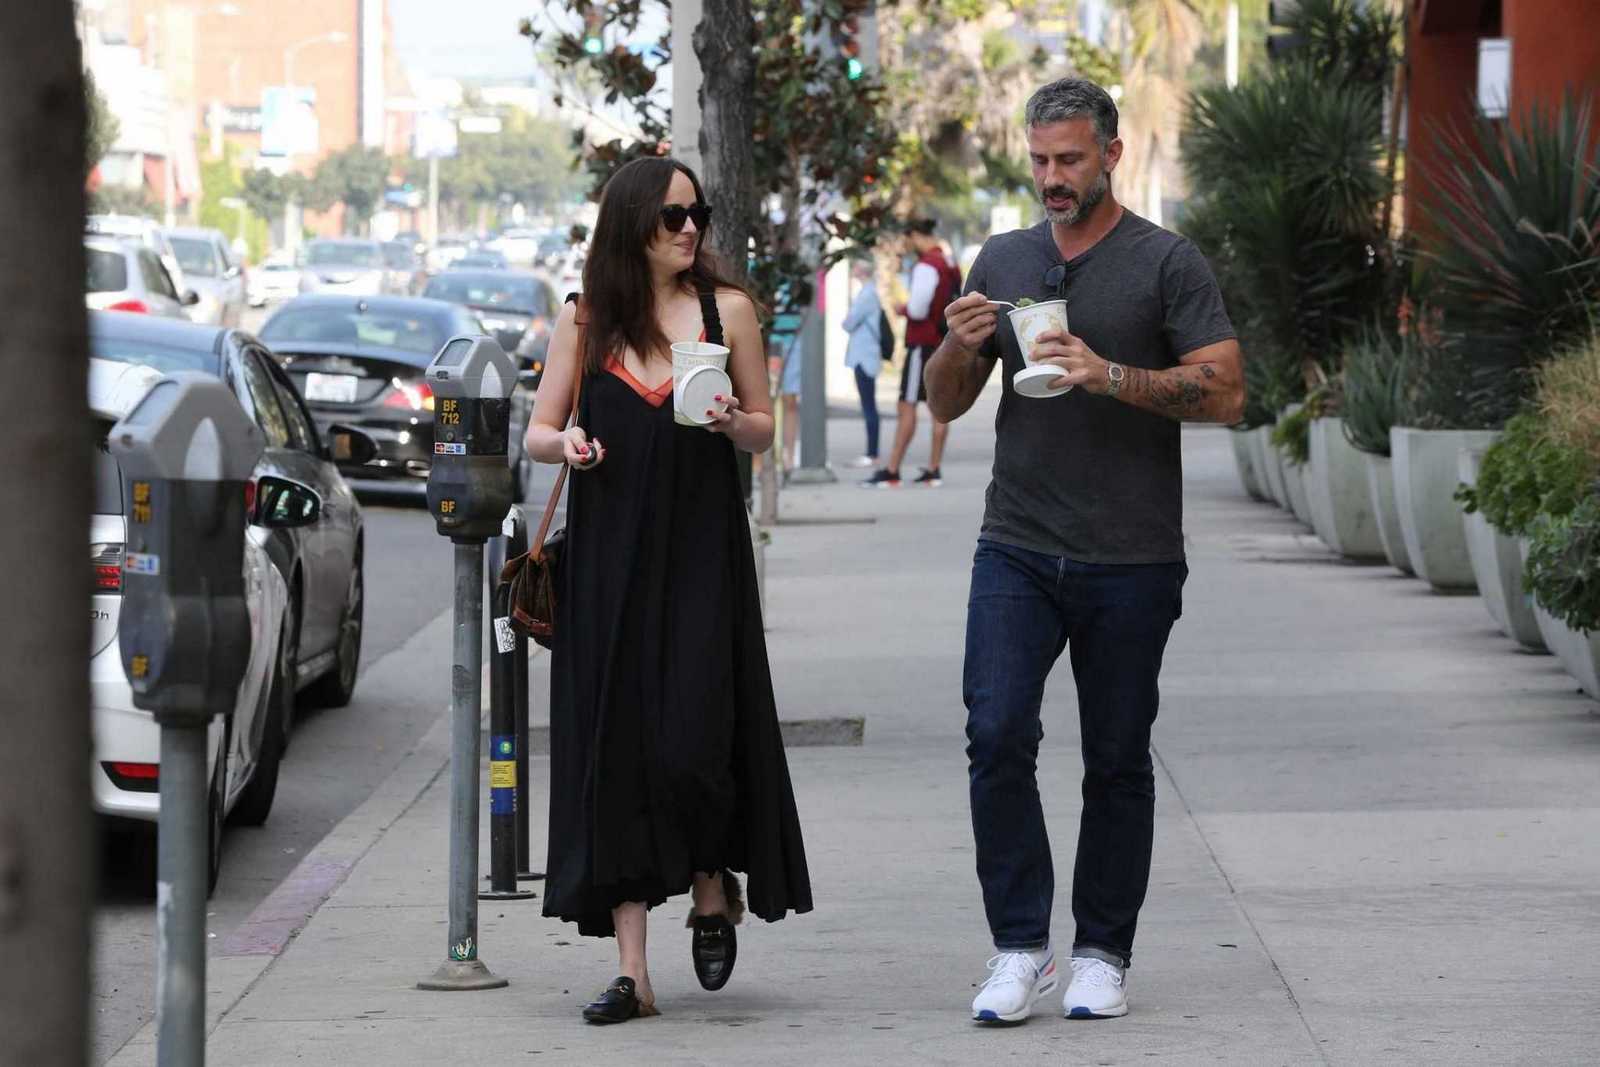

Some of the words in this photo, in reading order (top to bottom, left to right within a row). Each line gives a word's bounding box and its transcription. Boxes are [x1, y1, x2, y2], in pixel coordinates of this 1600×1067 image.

[443, 400, 457, 411] BF
[442, 412, 460, 424] 712
[441, 500, 455, 512] BF
